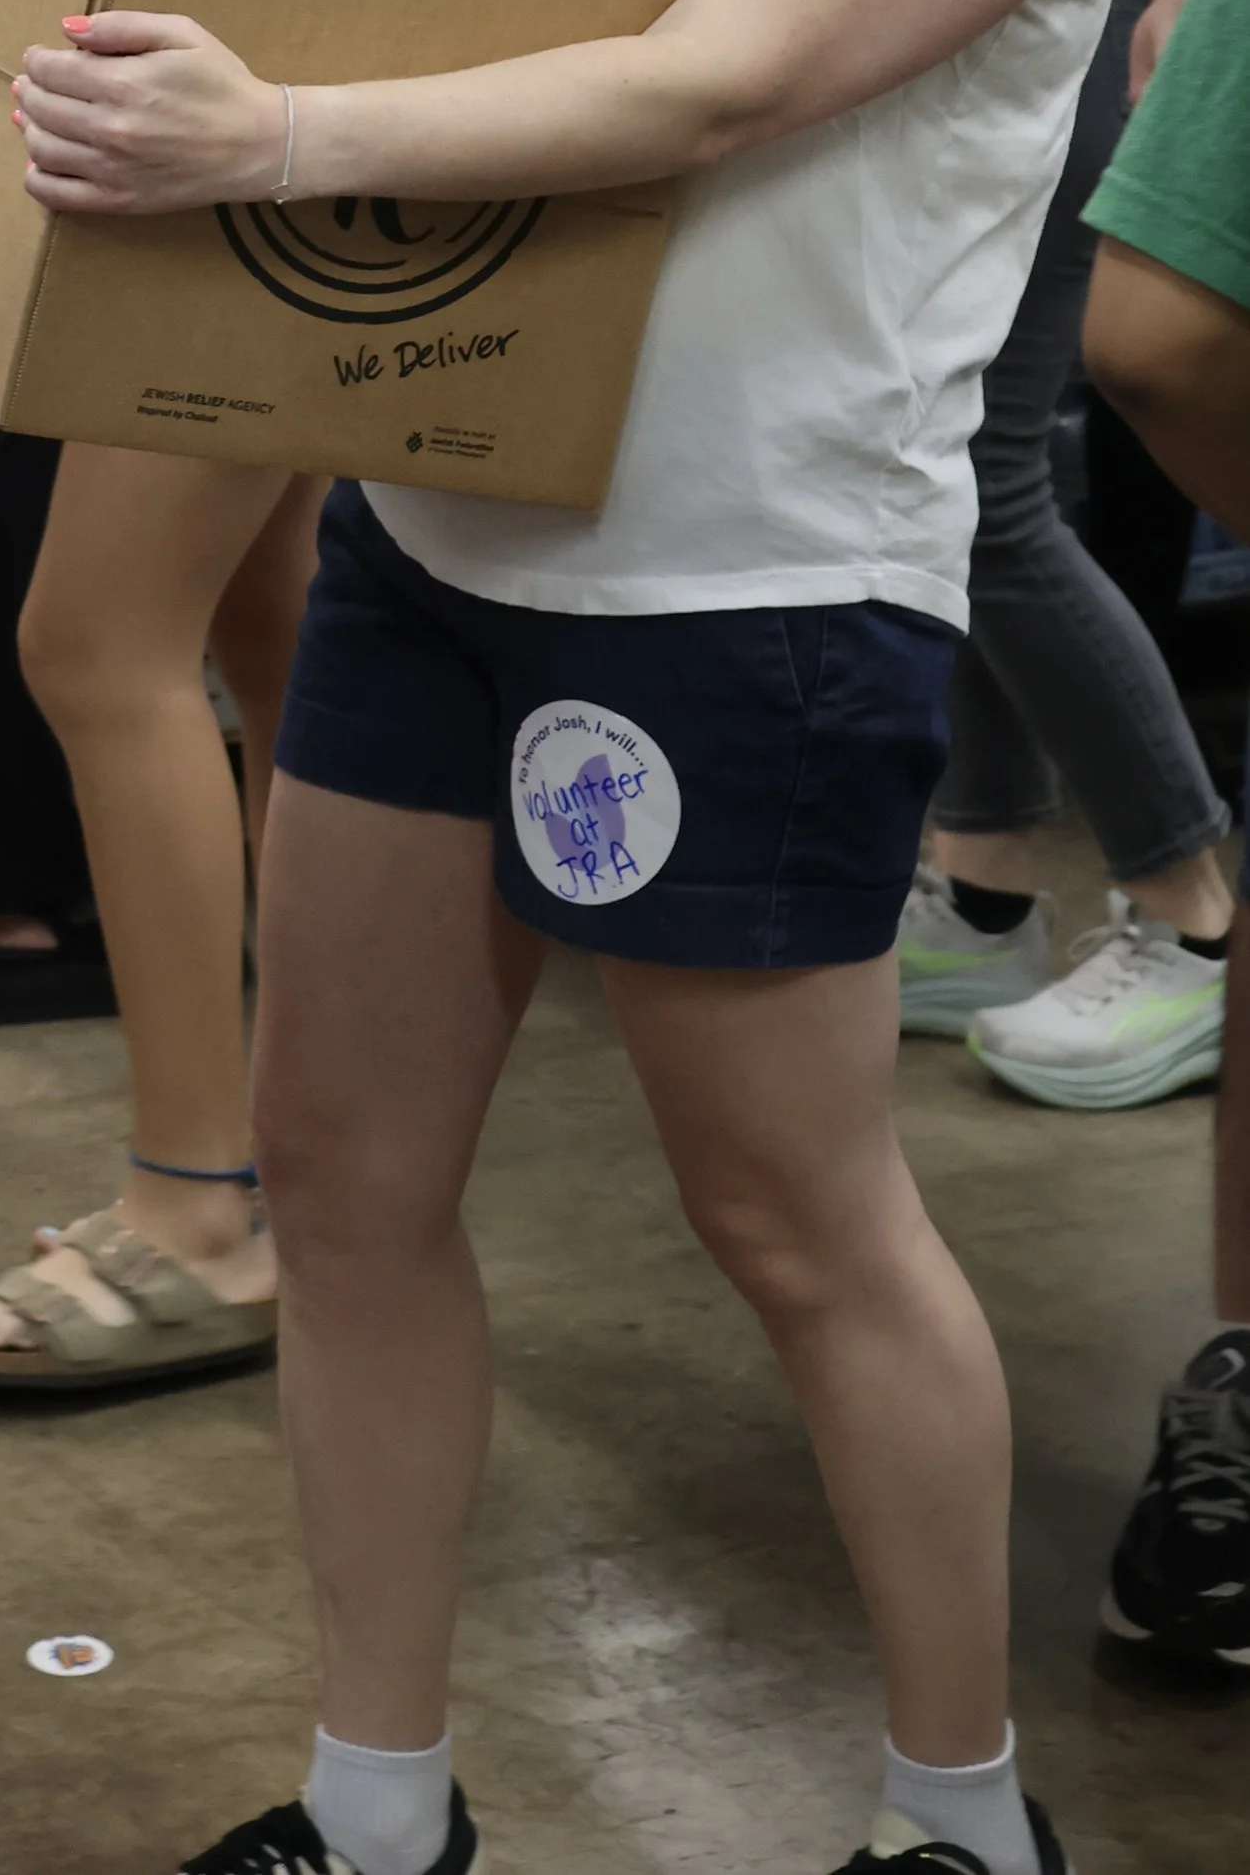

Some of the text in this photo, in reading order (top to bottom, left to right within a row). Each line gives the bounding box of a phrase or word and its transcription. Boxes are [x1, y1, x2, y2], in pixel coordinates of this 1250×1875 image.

[333, 329, 520, 387] We Deliver
[141, 387, 186, 403] JEWISH
[228, 399, 276, 415] AGENCY
[520, 725, 550, 765] honor
[553, 715, 591, 733] Josh,
[570, 812, 599, 847] at
[555, 840, 641, 899] JRA
